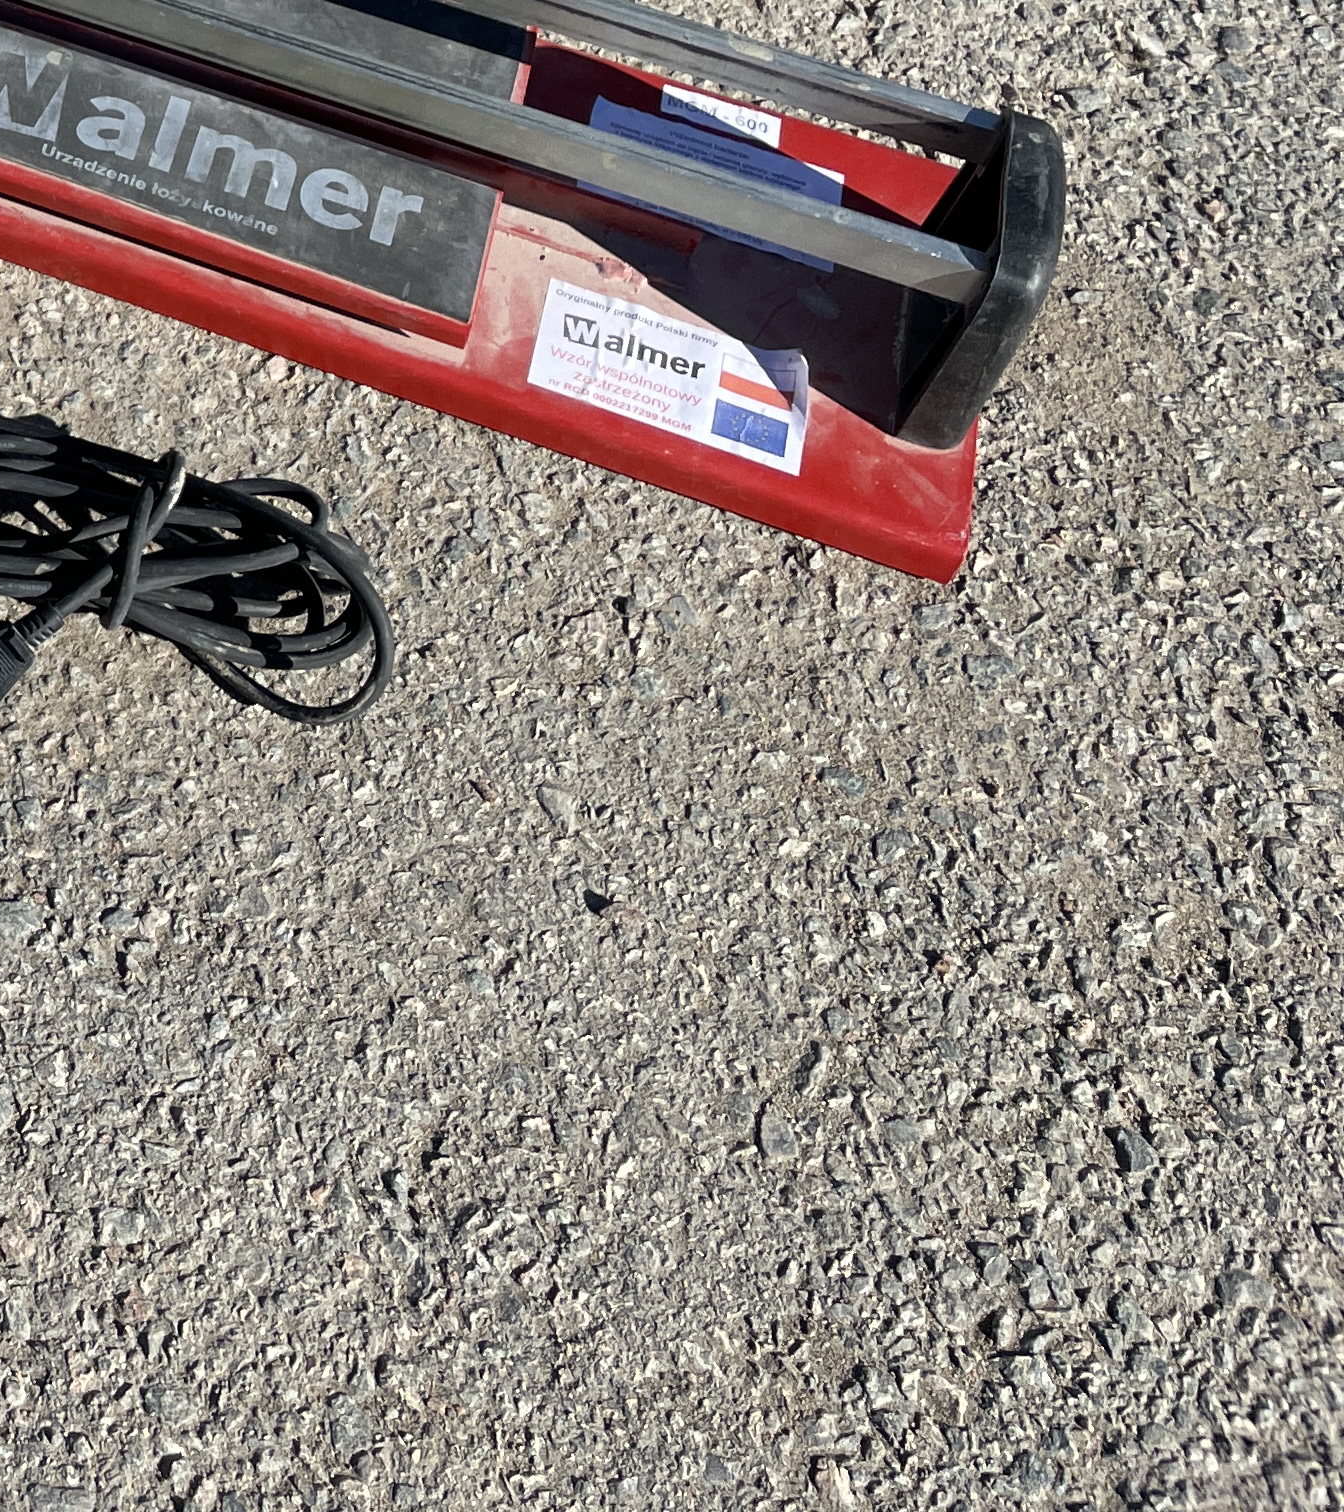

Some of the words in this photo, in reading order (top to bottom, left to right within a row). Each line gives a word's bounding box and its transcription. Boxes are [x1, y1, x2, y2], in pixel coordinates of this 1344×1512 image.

[666, 92, 717, 118] MGM
[735, 117, 768, 134] 600
[41, 142, 147, 191] Urządzenie
[555, 288, 611, 313] Oryginalny
[613, 307, 654, 327] produkt
[656, 321, 689, 338] Polski
[691, 332, 719, 348] firmy
[563, 313, 706, 379] Walmer
[551, 344, 592, 368] Wzór
[597, 362, 702, 407] wspólnotowy
[573, 371, 672, 413] zastrzeżony
[548, 378, 561, 387] nr
[563, 381, 590, 396] RCD
[661, 414, 692, 432] MGM
